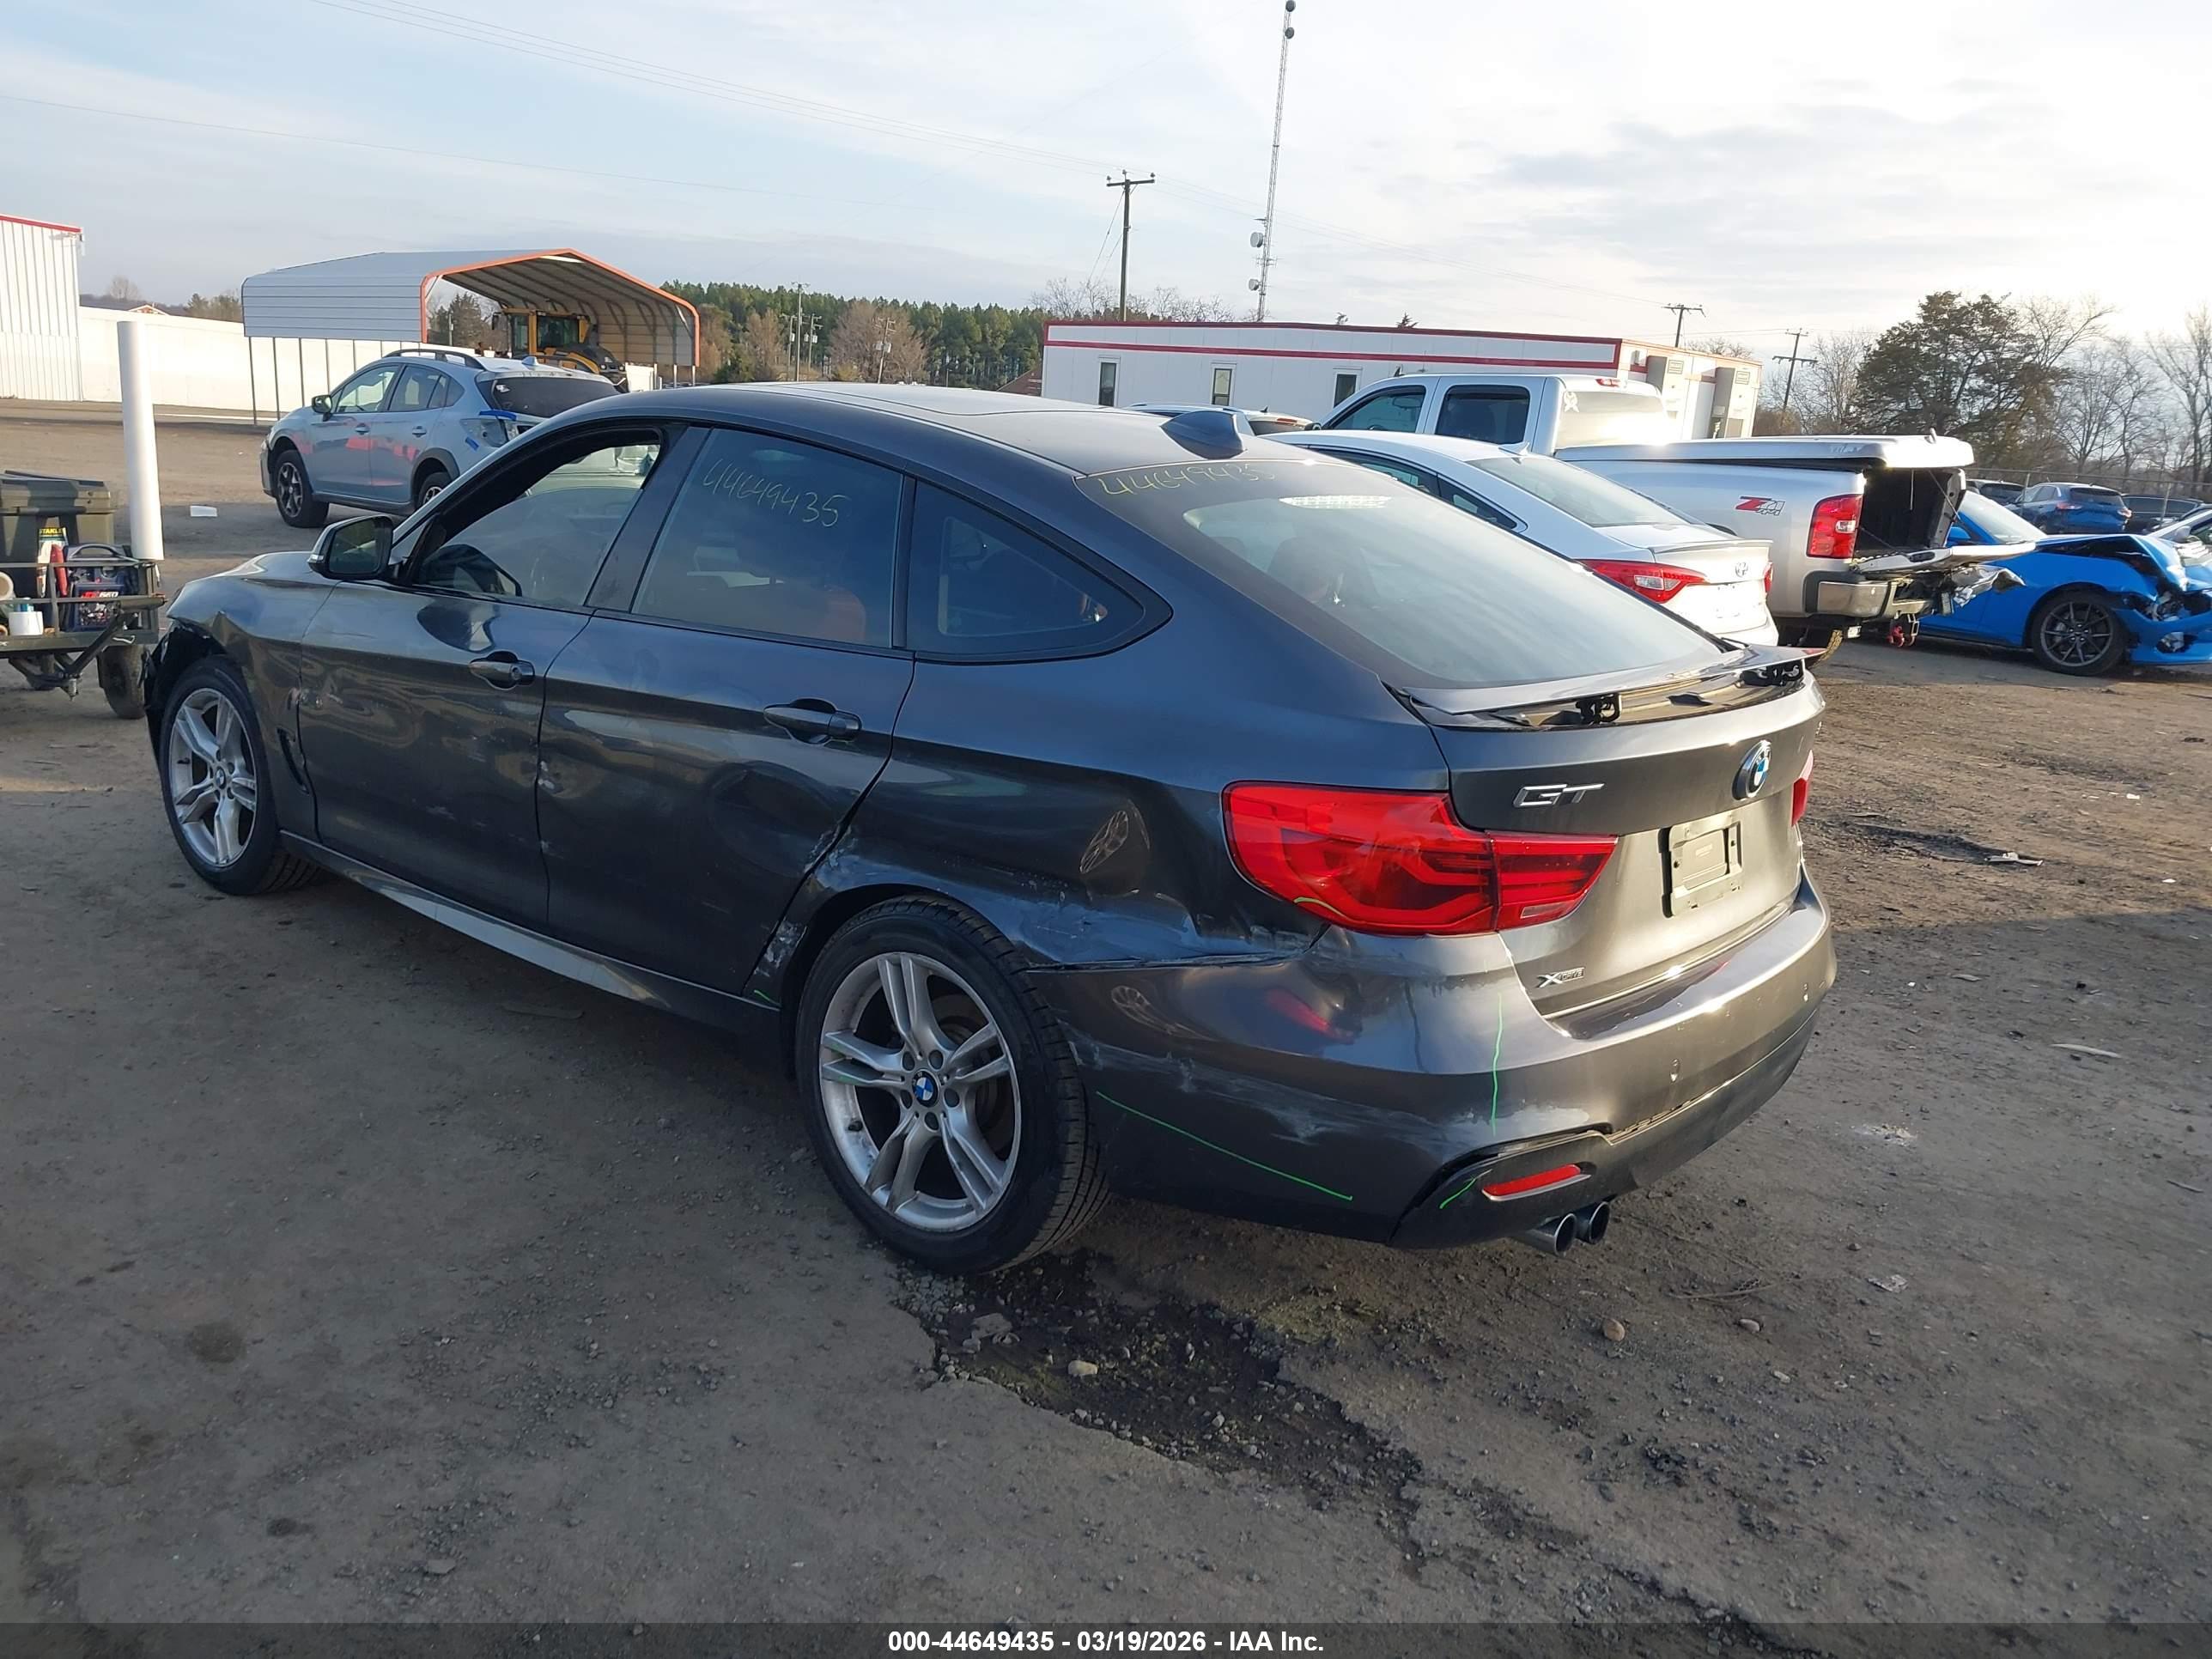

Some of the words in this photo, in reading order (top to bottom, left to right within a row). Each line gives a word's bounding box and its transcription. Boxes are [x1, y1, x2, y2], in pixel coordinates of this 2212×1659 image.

[703, 459, 851, 526] 44649435
[1735, 495, 1785, 512] Z71
[1513, 783, 1605, 807] GT
